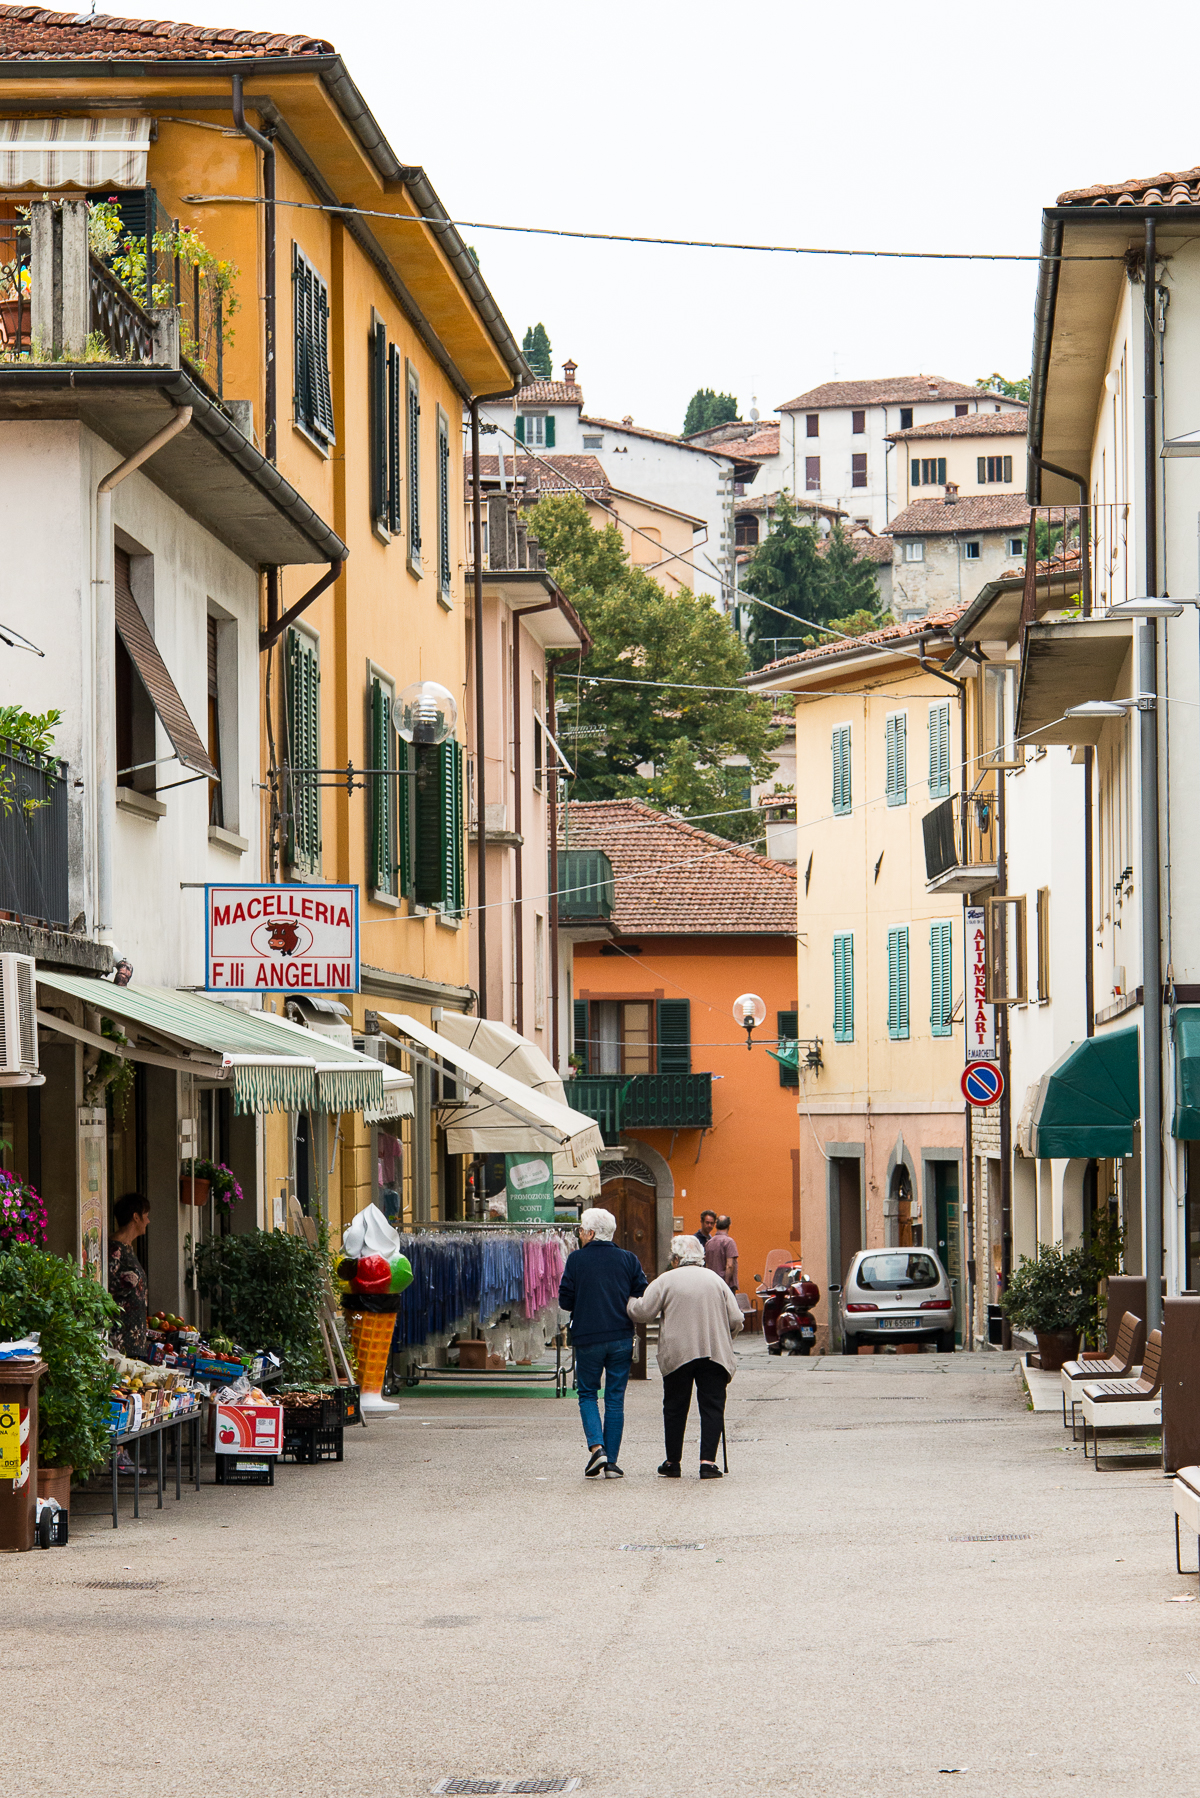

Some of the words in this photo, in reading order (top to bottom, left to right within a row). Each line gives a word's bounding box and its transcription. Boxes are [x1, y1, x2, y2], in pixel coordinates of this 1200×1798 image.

[214, 895, 350, 927] MACELLERIA
[213, 963, 244, 986] F.lli
[255, 962, 350, 987] ANGELINI
[973, 928, 987, 1045] ALIMENTARI
